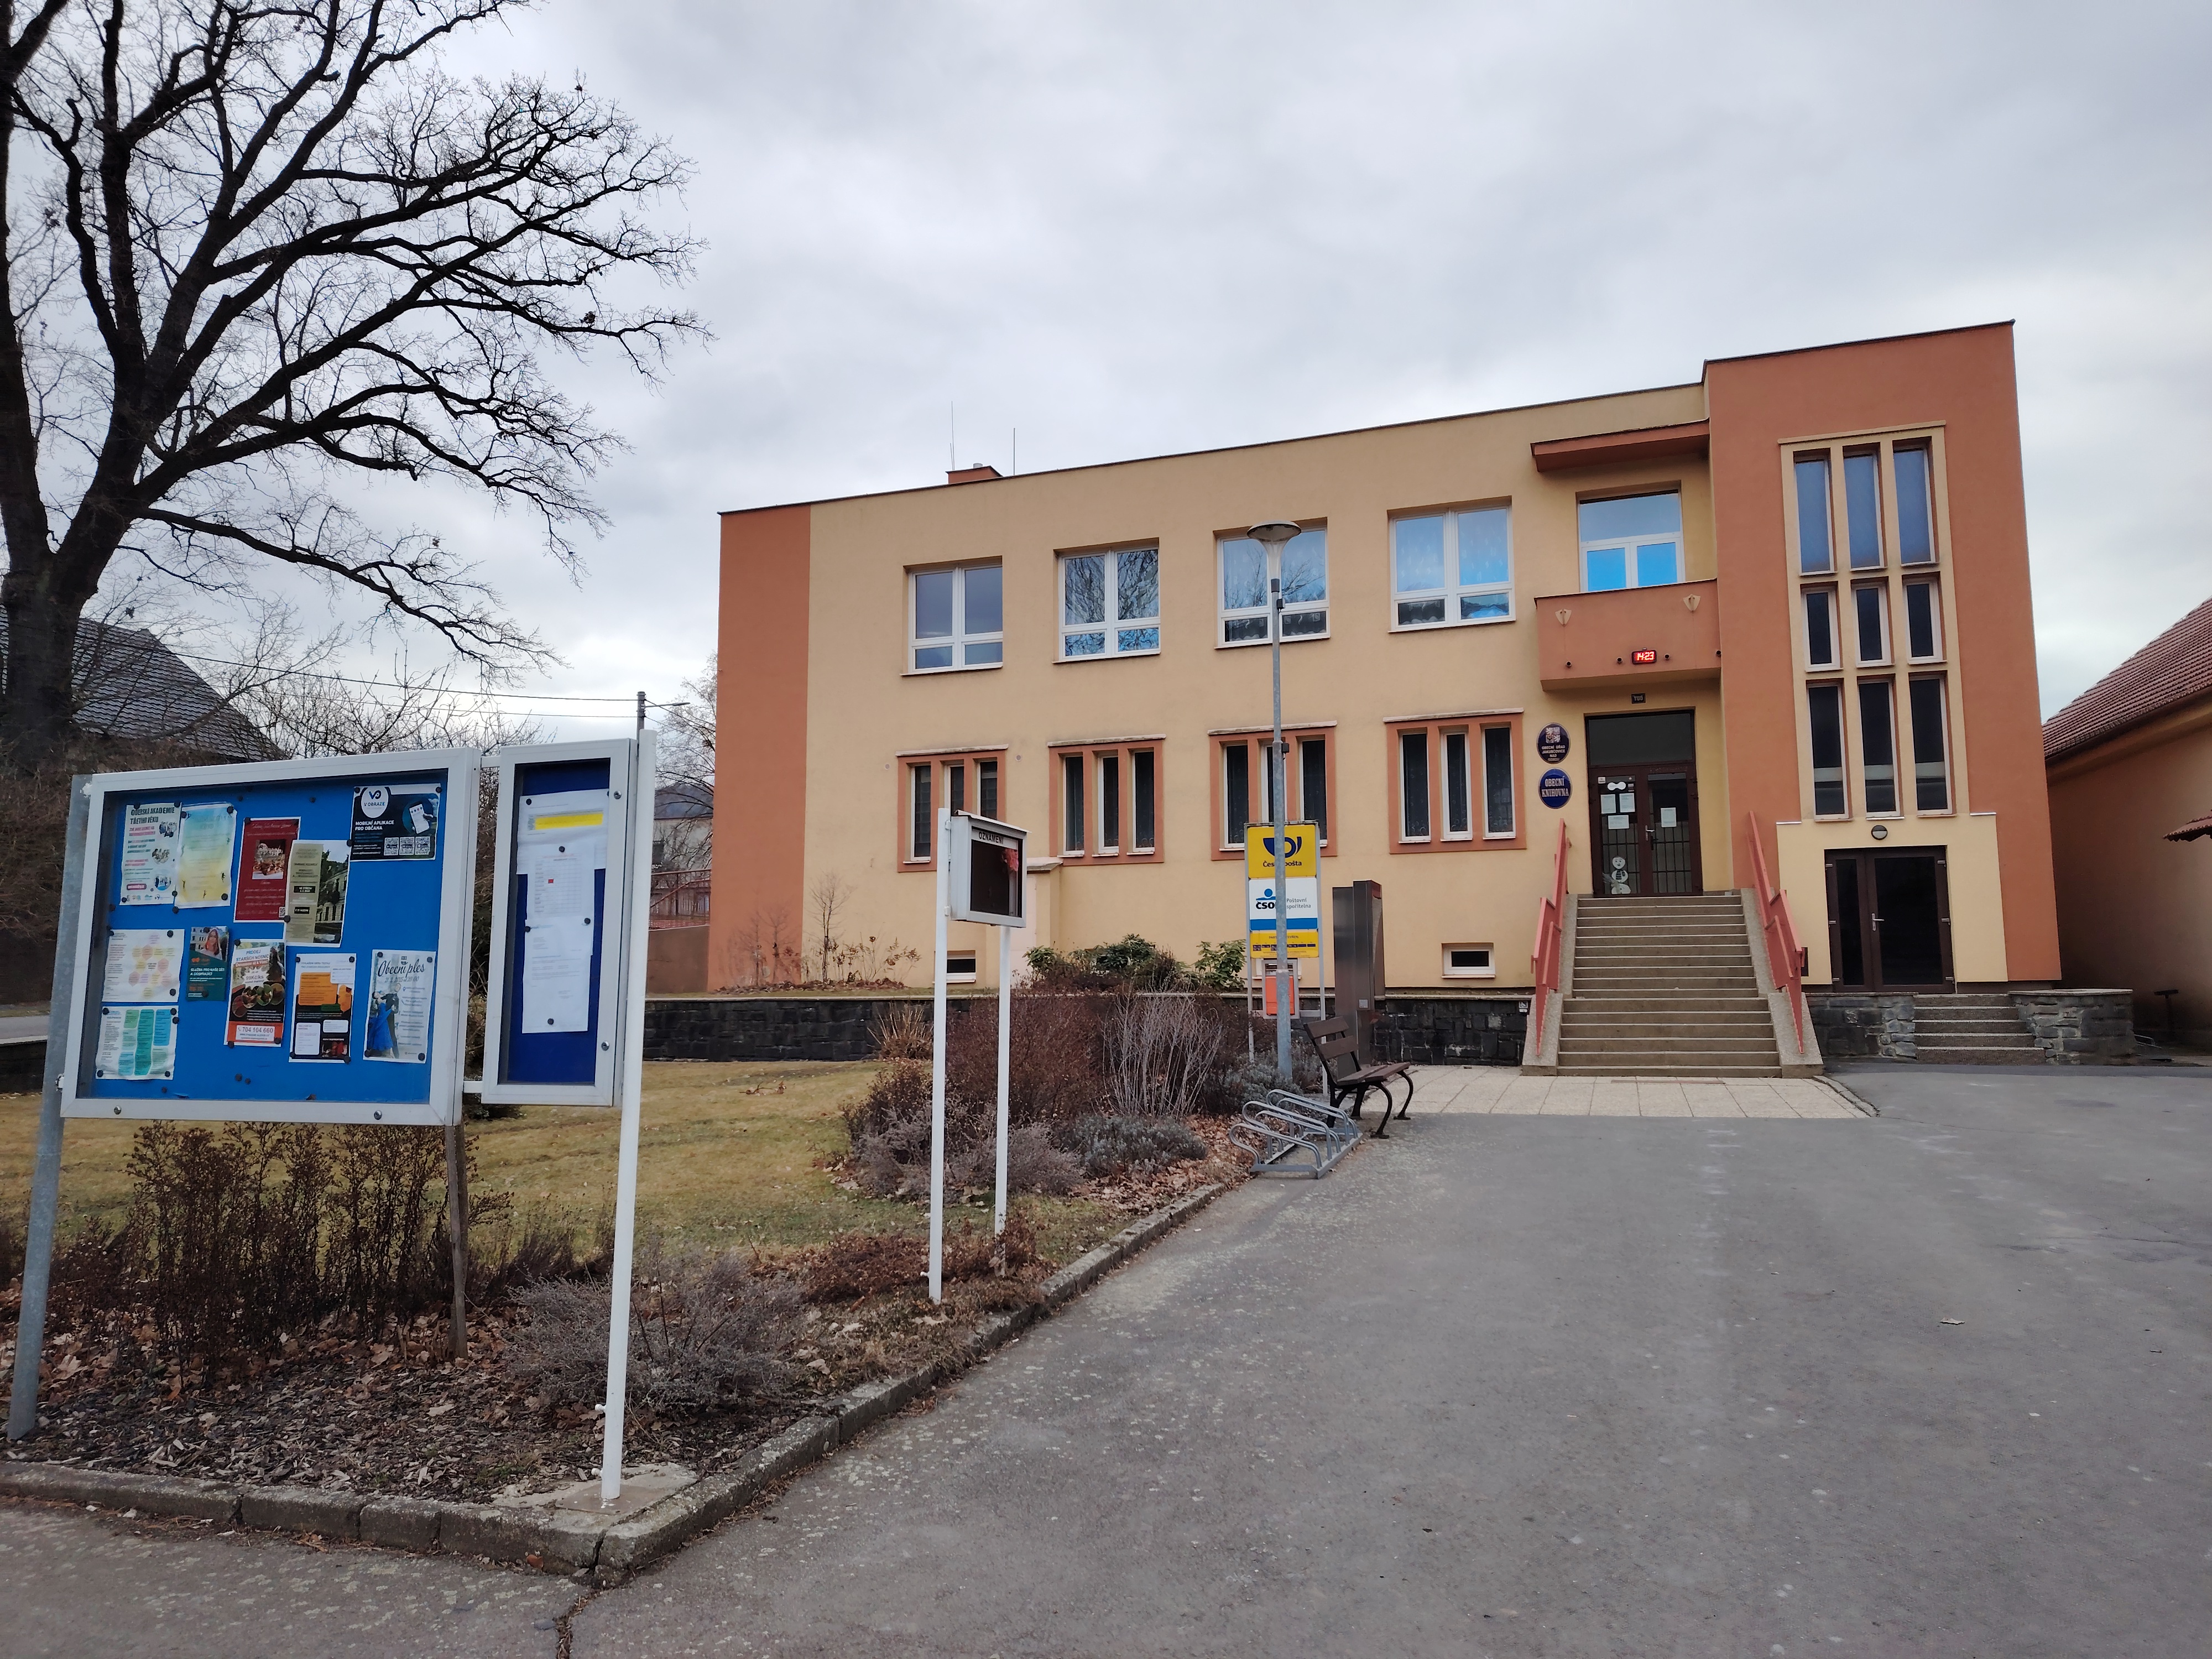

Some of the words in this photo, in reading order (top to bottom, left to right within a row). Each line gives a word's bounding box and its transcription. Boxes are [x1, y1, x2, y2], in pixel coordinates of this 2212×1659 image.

[1545, 775, 1564, 787] OBECNÍ
[1541, 788, 1569, 797] KNIHOVNA
[1256, 901, 1276, 910] ČSO
[405, 958, 425, 978] ples
